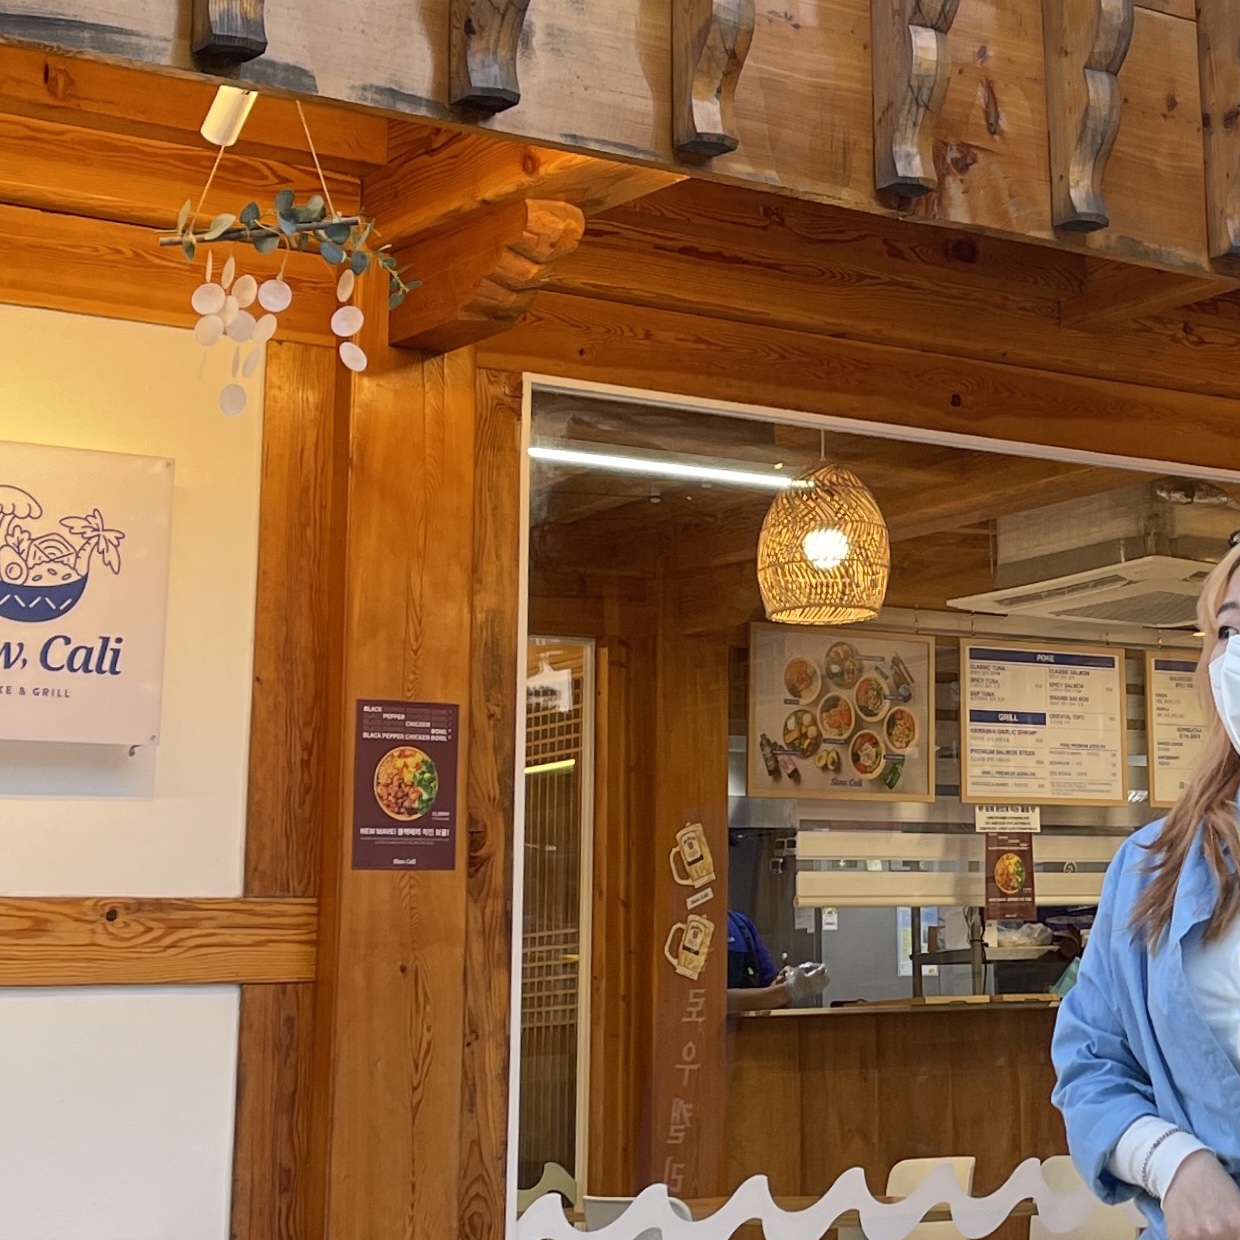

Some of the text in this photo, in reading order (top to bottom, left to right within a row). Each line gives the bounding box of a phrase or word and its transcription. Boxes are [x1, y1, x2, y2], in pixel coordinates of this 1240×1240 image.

[39, 634, 124, 675] Cali
[19, 686, 26, 695] &
[32, 687, 70, 698] GRILL
[998, 713, 1019, 722] GRILL
[382, 732, 404, 740] PEPPER
[405, 733, 430, 741] CHICKEN
